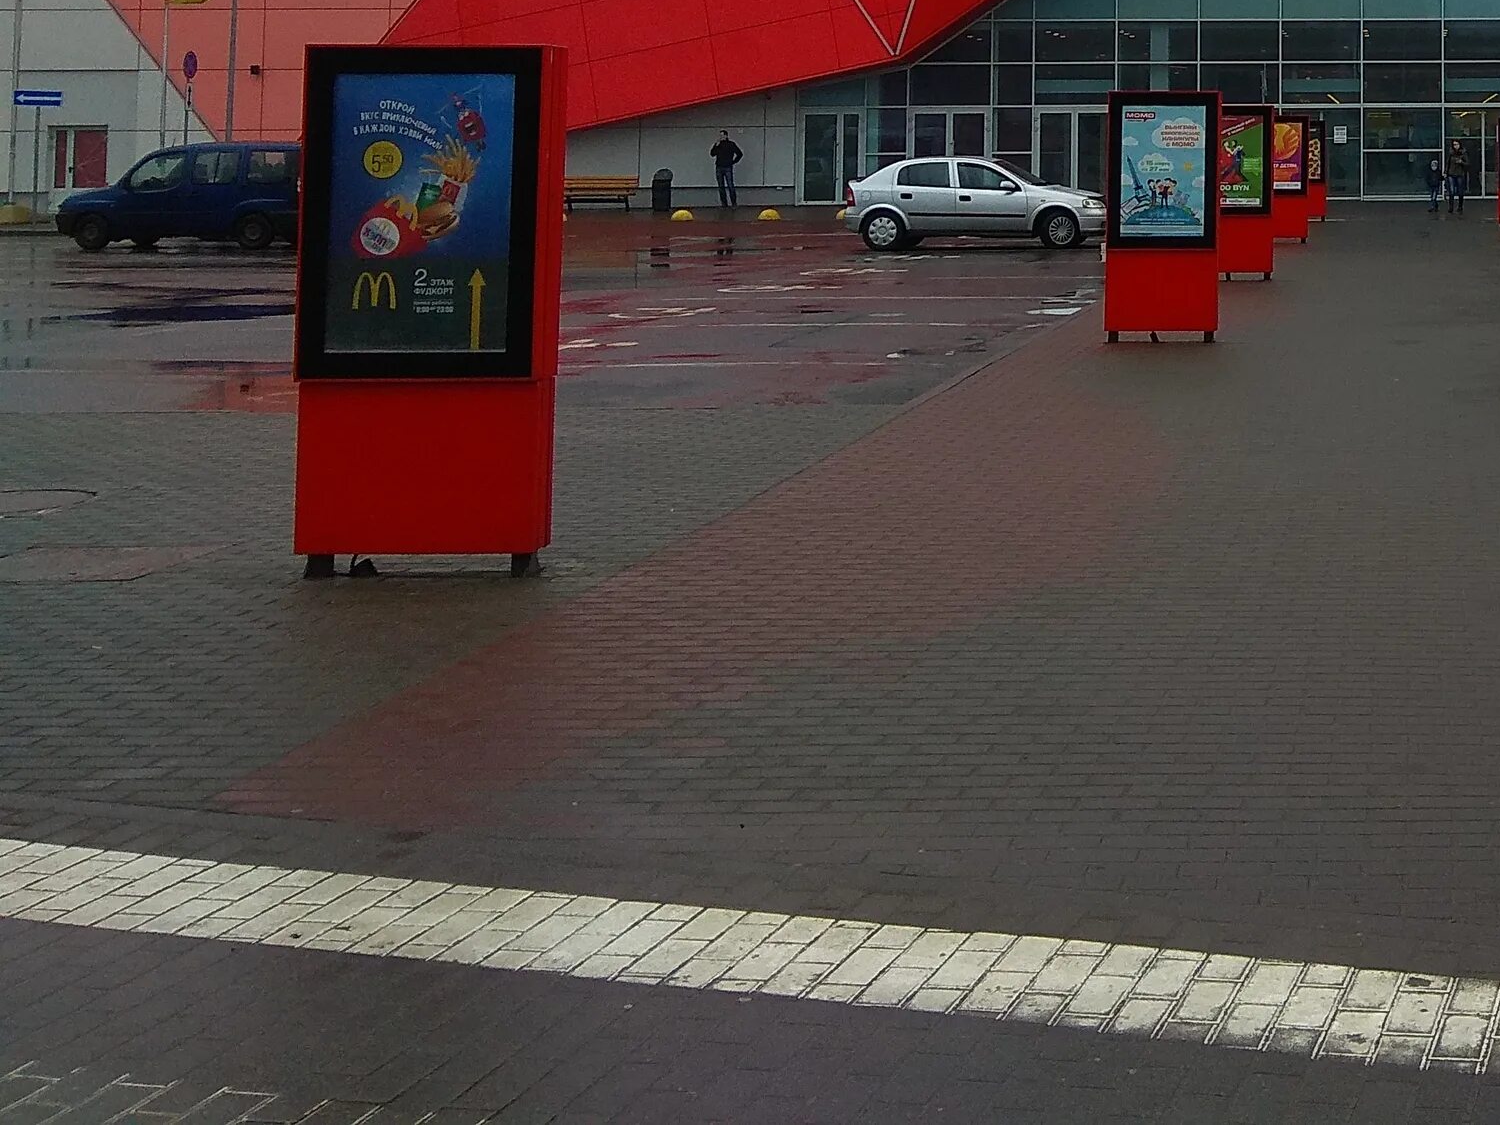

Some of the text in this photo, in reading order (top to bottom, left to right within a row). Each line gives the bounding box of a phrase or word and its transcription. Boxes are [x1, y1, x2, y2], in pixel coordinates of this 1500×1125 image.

[379, 100, 415, 115] ОТКРОЙ
[414, 268, 454, 287] 2 ЭТАЖ
[413, 287, 454, 295] ФУДКОРТ
